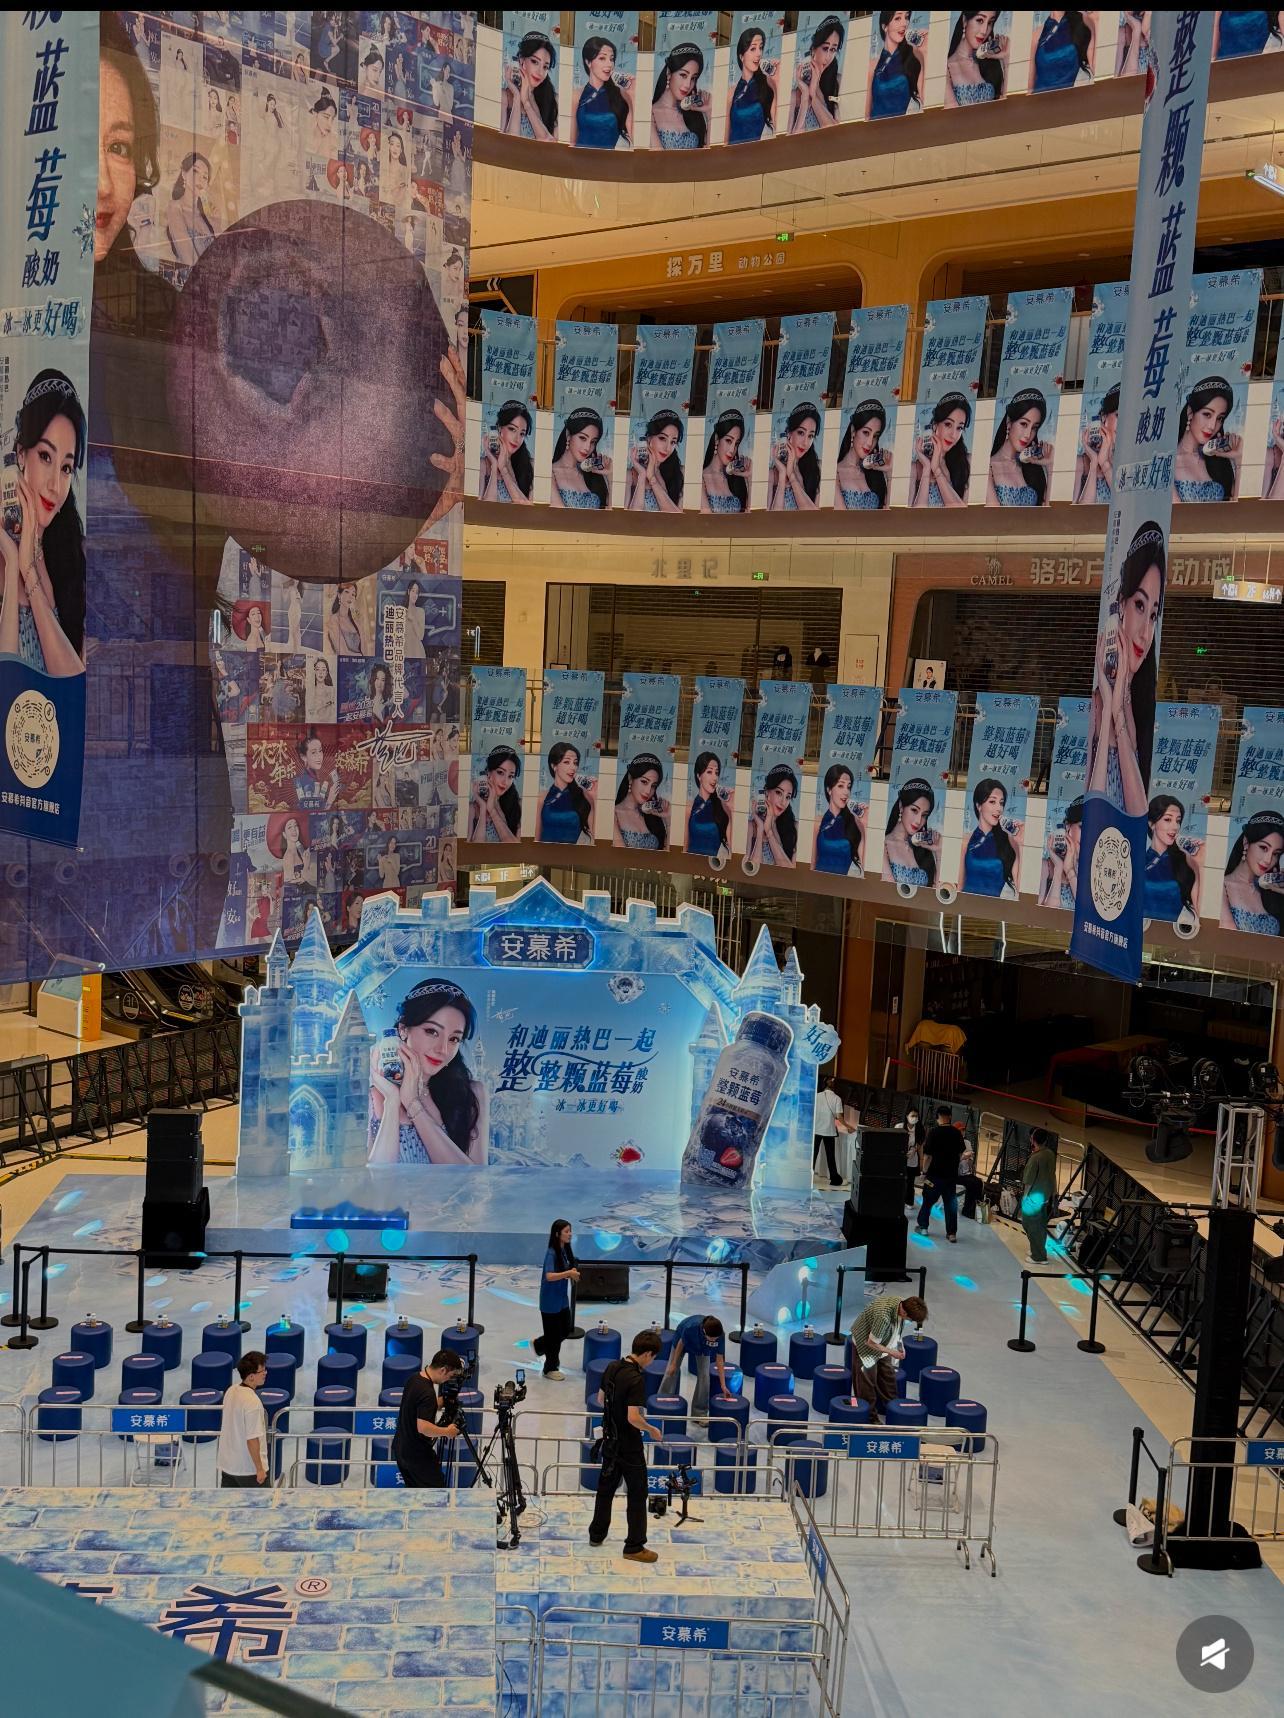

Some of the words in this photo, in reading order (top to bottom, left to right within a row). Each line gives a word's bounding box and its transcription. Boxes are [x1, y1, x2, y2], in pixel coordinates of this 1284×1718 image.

[22, 11, 69, 242] 蓝莓
[21, 249, 59, 289] 酸奶
[667, 251, 723, 278] 探万里
[738, 252, 785, 269] 动物公园
[1207, 274, 1241, 289] 安慕希
[3, 300, 80, 337] 冰一冰更好喝
[1135, 405, 1165, 446] 酸奶
[970, 575, 1014, 586] CAMEL
[384, 606, 395, 662] 迪丽热巴
[556, 711, 589, 726] 超好喝
[1168, 707, 1200, 719] 安慕希
[703, 720, 731, 735] 超好喝
[834, 731, 866, 747] 超好喝
[1155, 737, 1206, 757] 整颗蓝莓
[984, 743, 1020, 760] 超好喝
[1157, 758, 1200, 775] 超好喝
[500, 933, 578, 961] 安慕希
[507, 1023, 657, 1053] 和迪丽热巴一起
[802, 1024, 833, 1062] 好喝
[729, 1067, 760, 1086] 安慕希
[715, 1077, 763, 1106] 整颗蓝莓
[555, 1098, 619, 1113] 冰一冰更好喝
[130, 1414, 169, 1427] 安慕希
[866, 1440, 904, 1454] 安慕希
[661, 1625, 708, 1643] 安慕希
